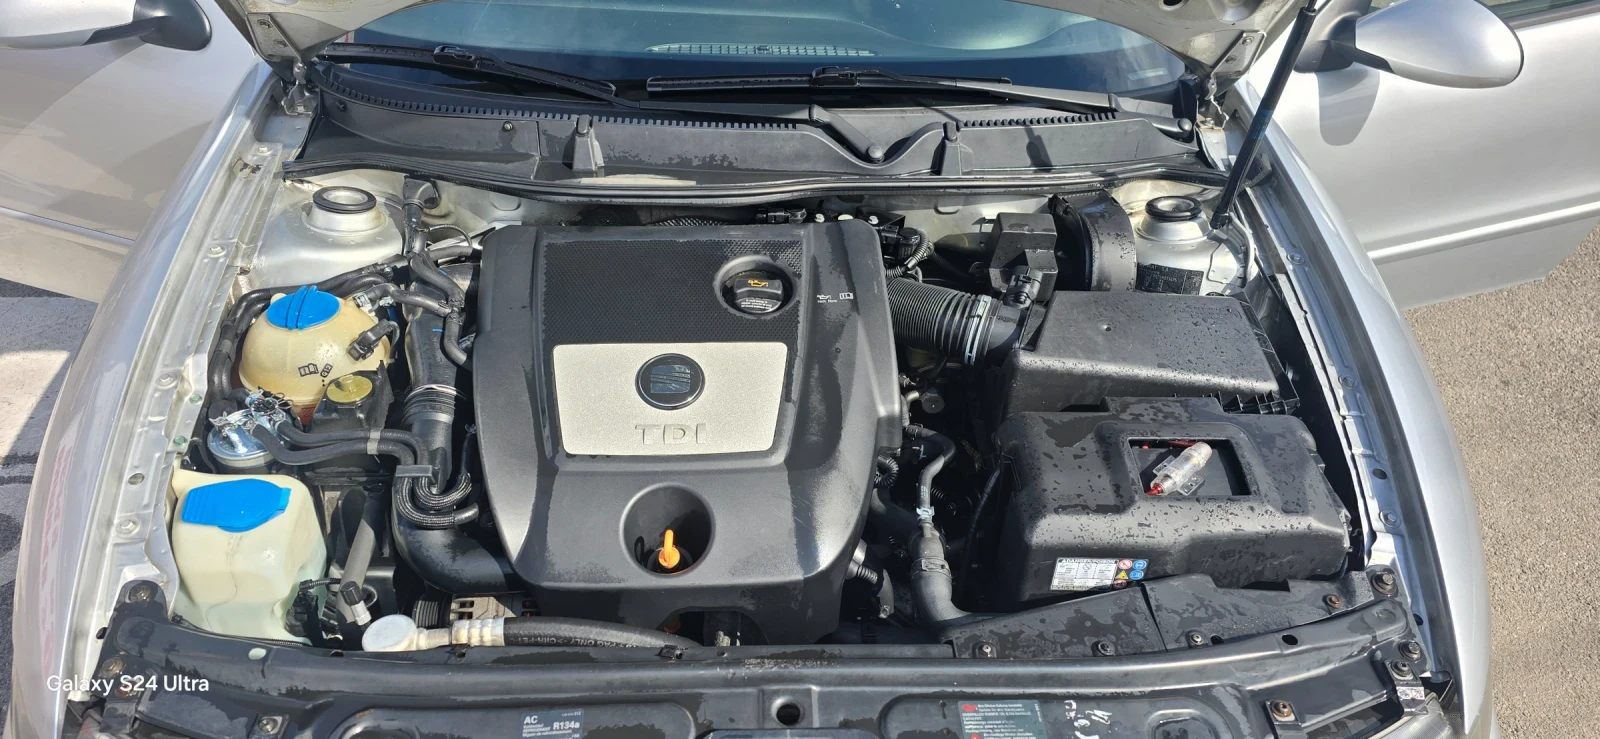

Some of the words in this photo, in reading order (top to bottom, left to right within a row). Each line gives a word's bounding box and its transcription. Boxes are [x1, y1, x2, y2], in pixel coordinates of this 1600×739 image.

[634, 423, 706, 445] TDI
[570, 638, 594, 647] ONLY
[524, 715, 538, 724] AC
[552, 720, 580, 730] R134a
